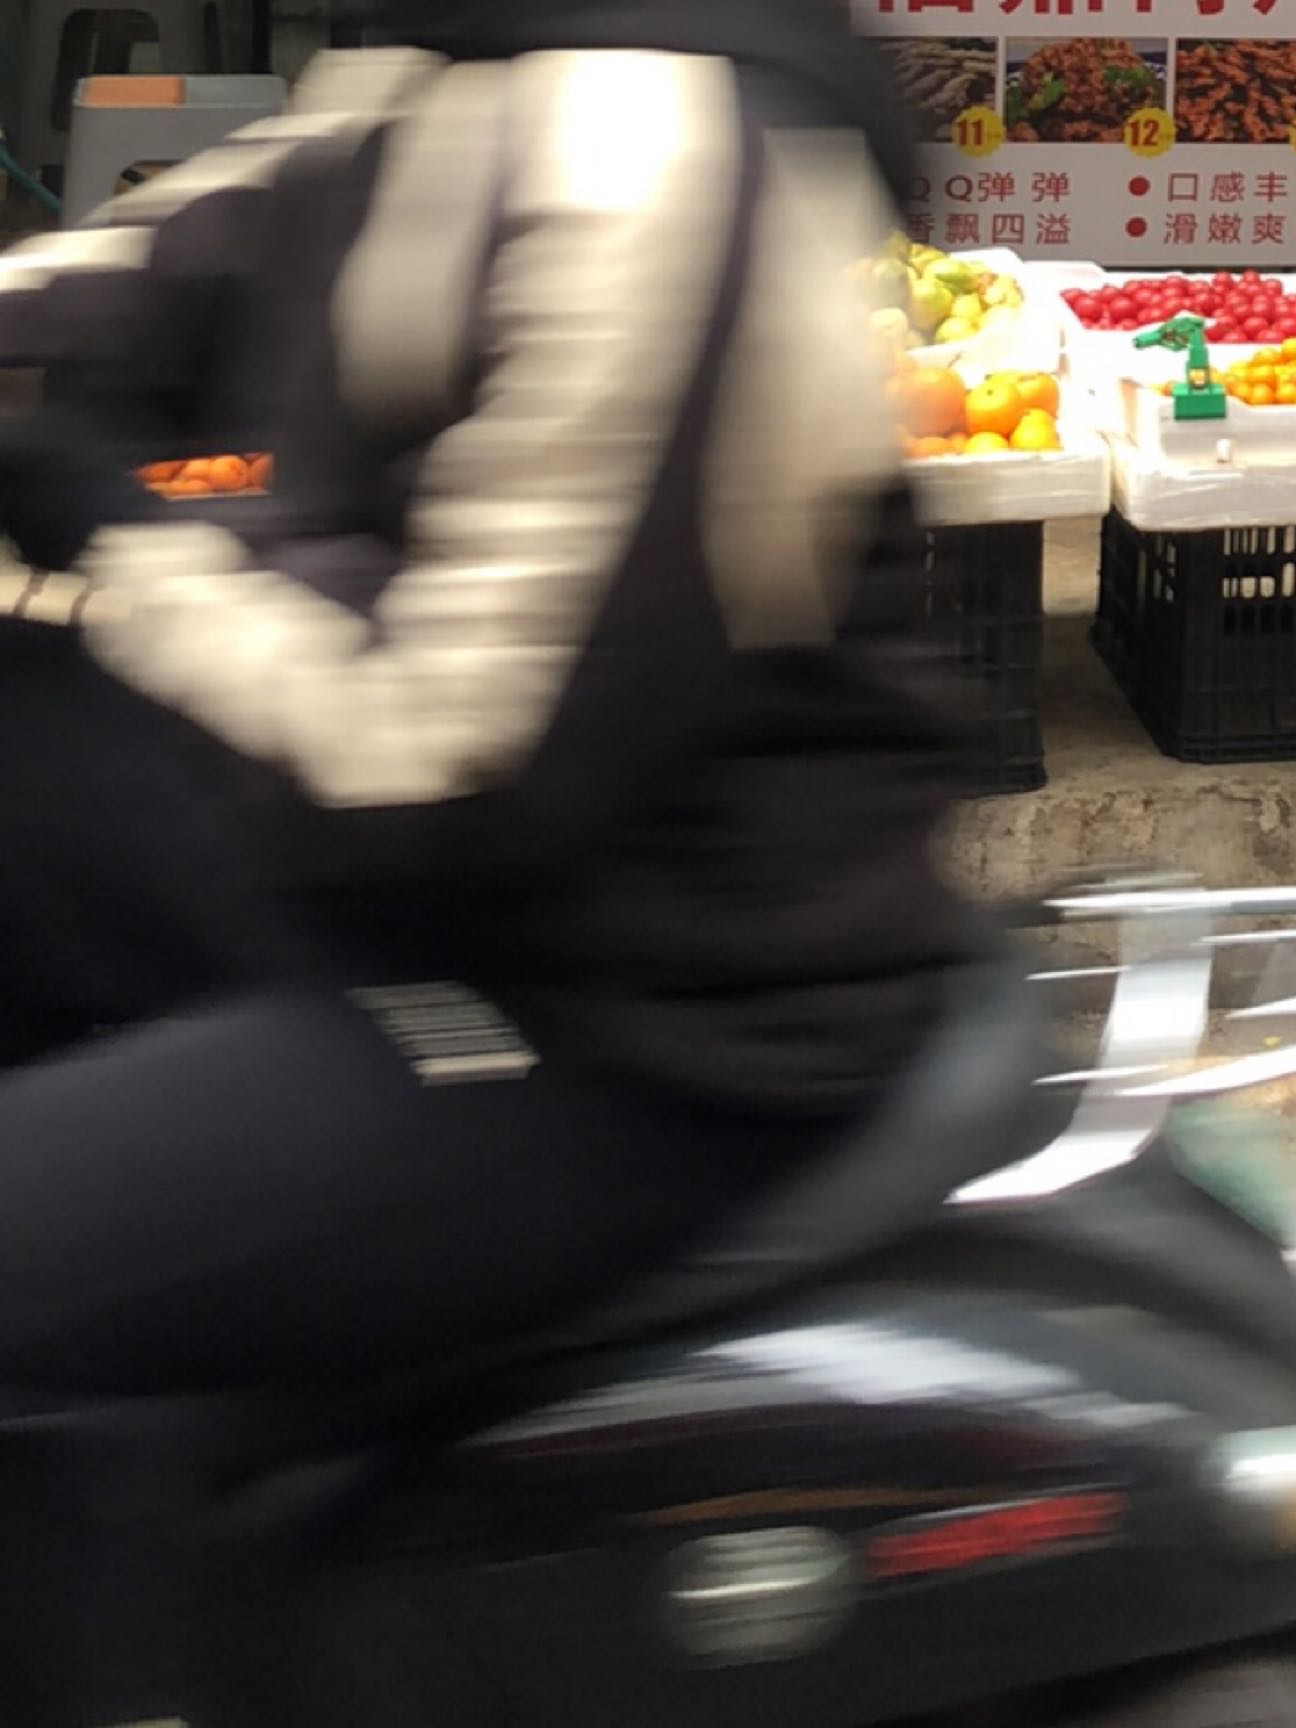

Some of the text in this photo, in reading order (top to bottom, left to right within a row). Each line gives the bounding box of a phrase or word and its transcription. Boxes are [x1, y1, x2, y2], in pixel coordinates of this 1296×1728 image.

[957, 118, 983, 145] 11
[1129, 118, 1160, 147] 12
[905, 172, 1069, 203] QQ弹弹
[906, 213, 1070, 245] 香飘四溢
